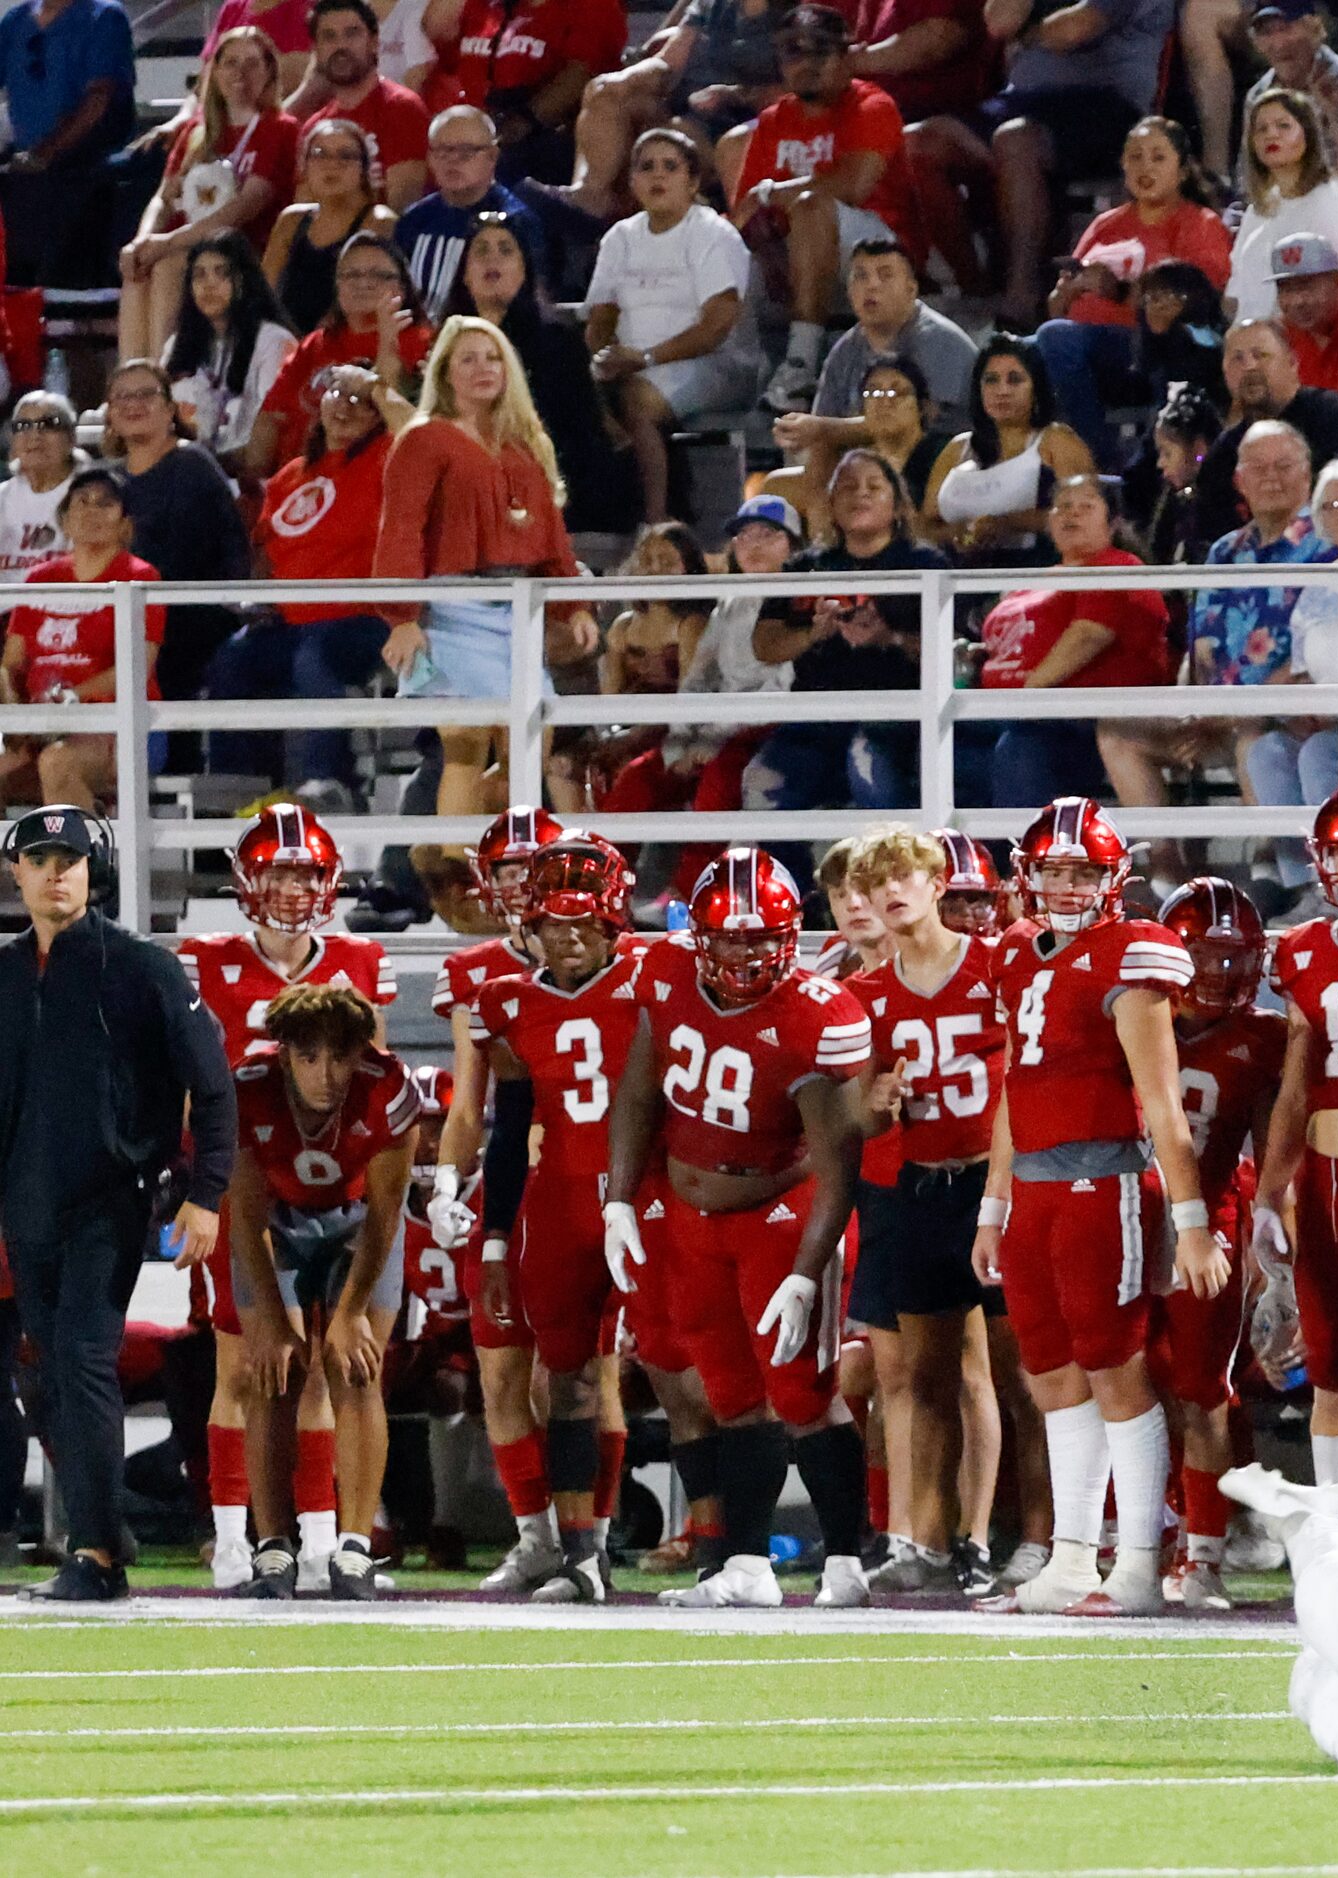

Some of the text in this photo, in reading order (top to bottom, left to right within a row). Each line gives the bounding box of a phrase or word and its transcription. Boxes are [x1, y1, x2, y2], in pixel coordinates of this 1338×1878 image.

[43, 815, 65, 834] W
[555, 1017, 610, 1124] 3
[892, 1013, 990, 1121] 25
[1017, 969, 1056, 1066] 4
[663, 1023, 755, 1134] 28
